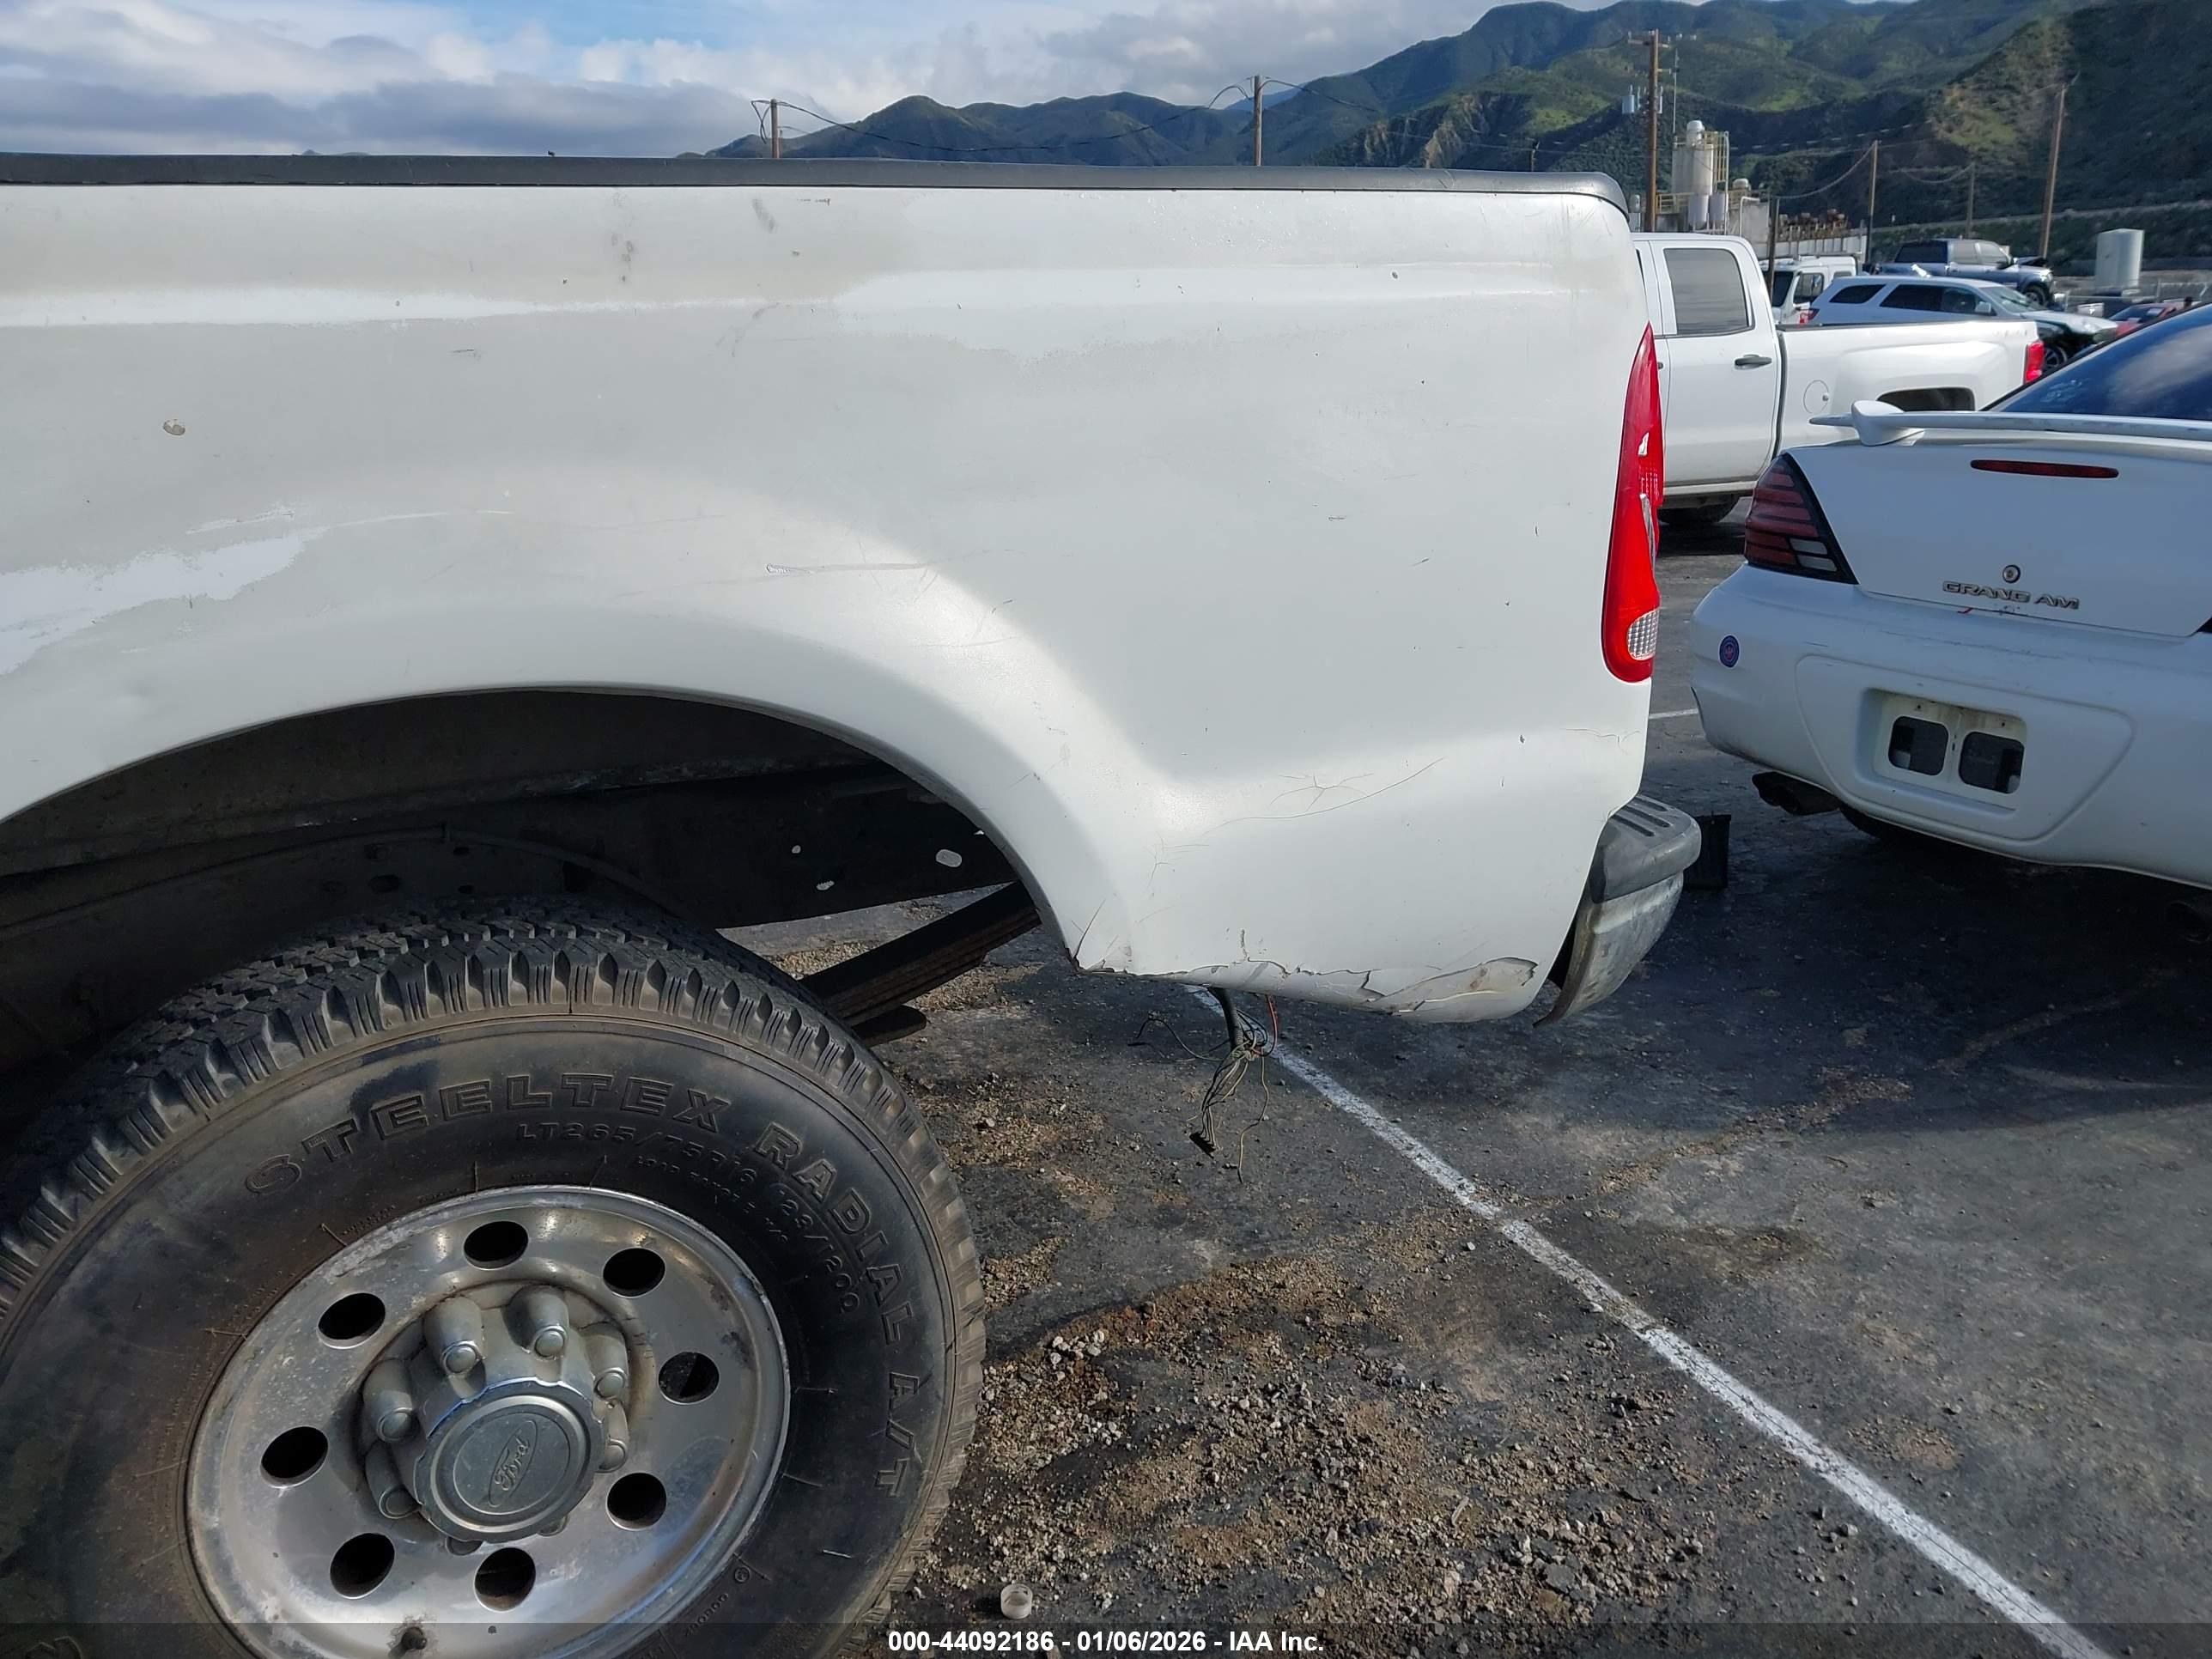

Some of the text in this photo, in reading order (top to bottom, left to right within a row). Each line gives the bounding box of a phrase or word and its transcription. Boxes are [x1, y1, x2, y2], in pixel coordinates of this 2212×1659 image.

[2033, 593, 2081, 611] AM
[244, 1072, 921, 1498] STEELTEX RADIAL A/T
[495, 1432, 530, 1492] Ford
